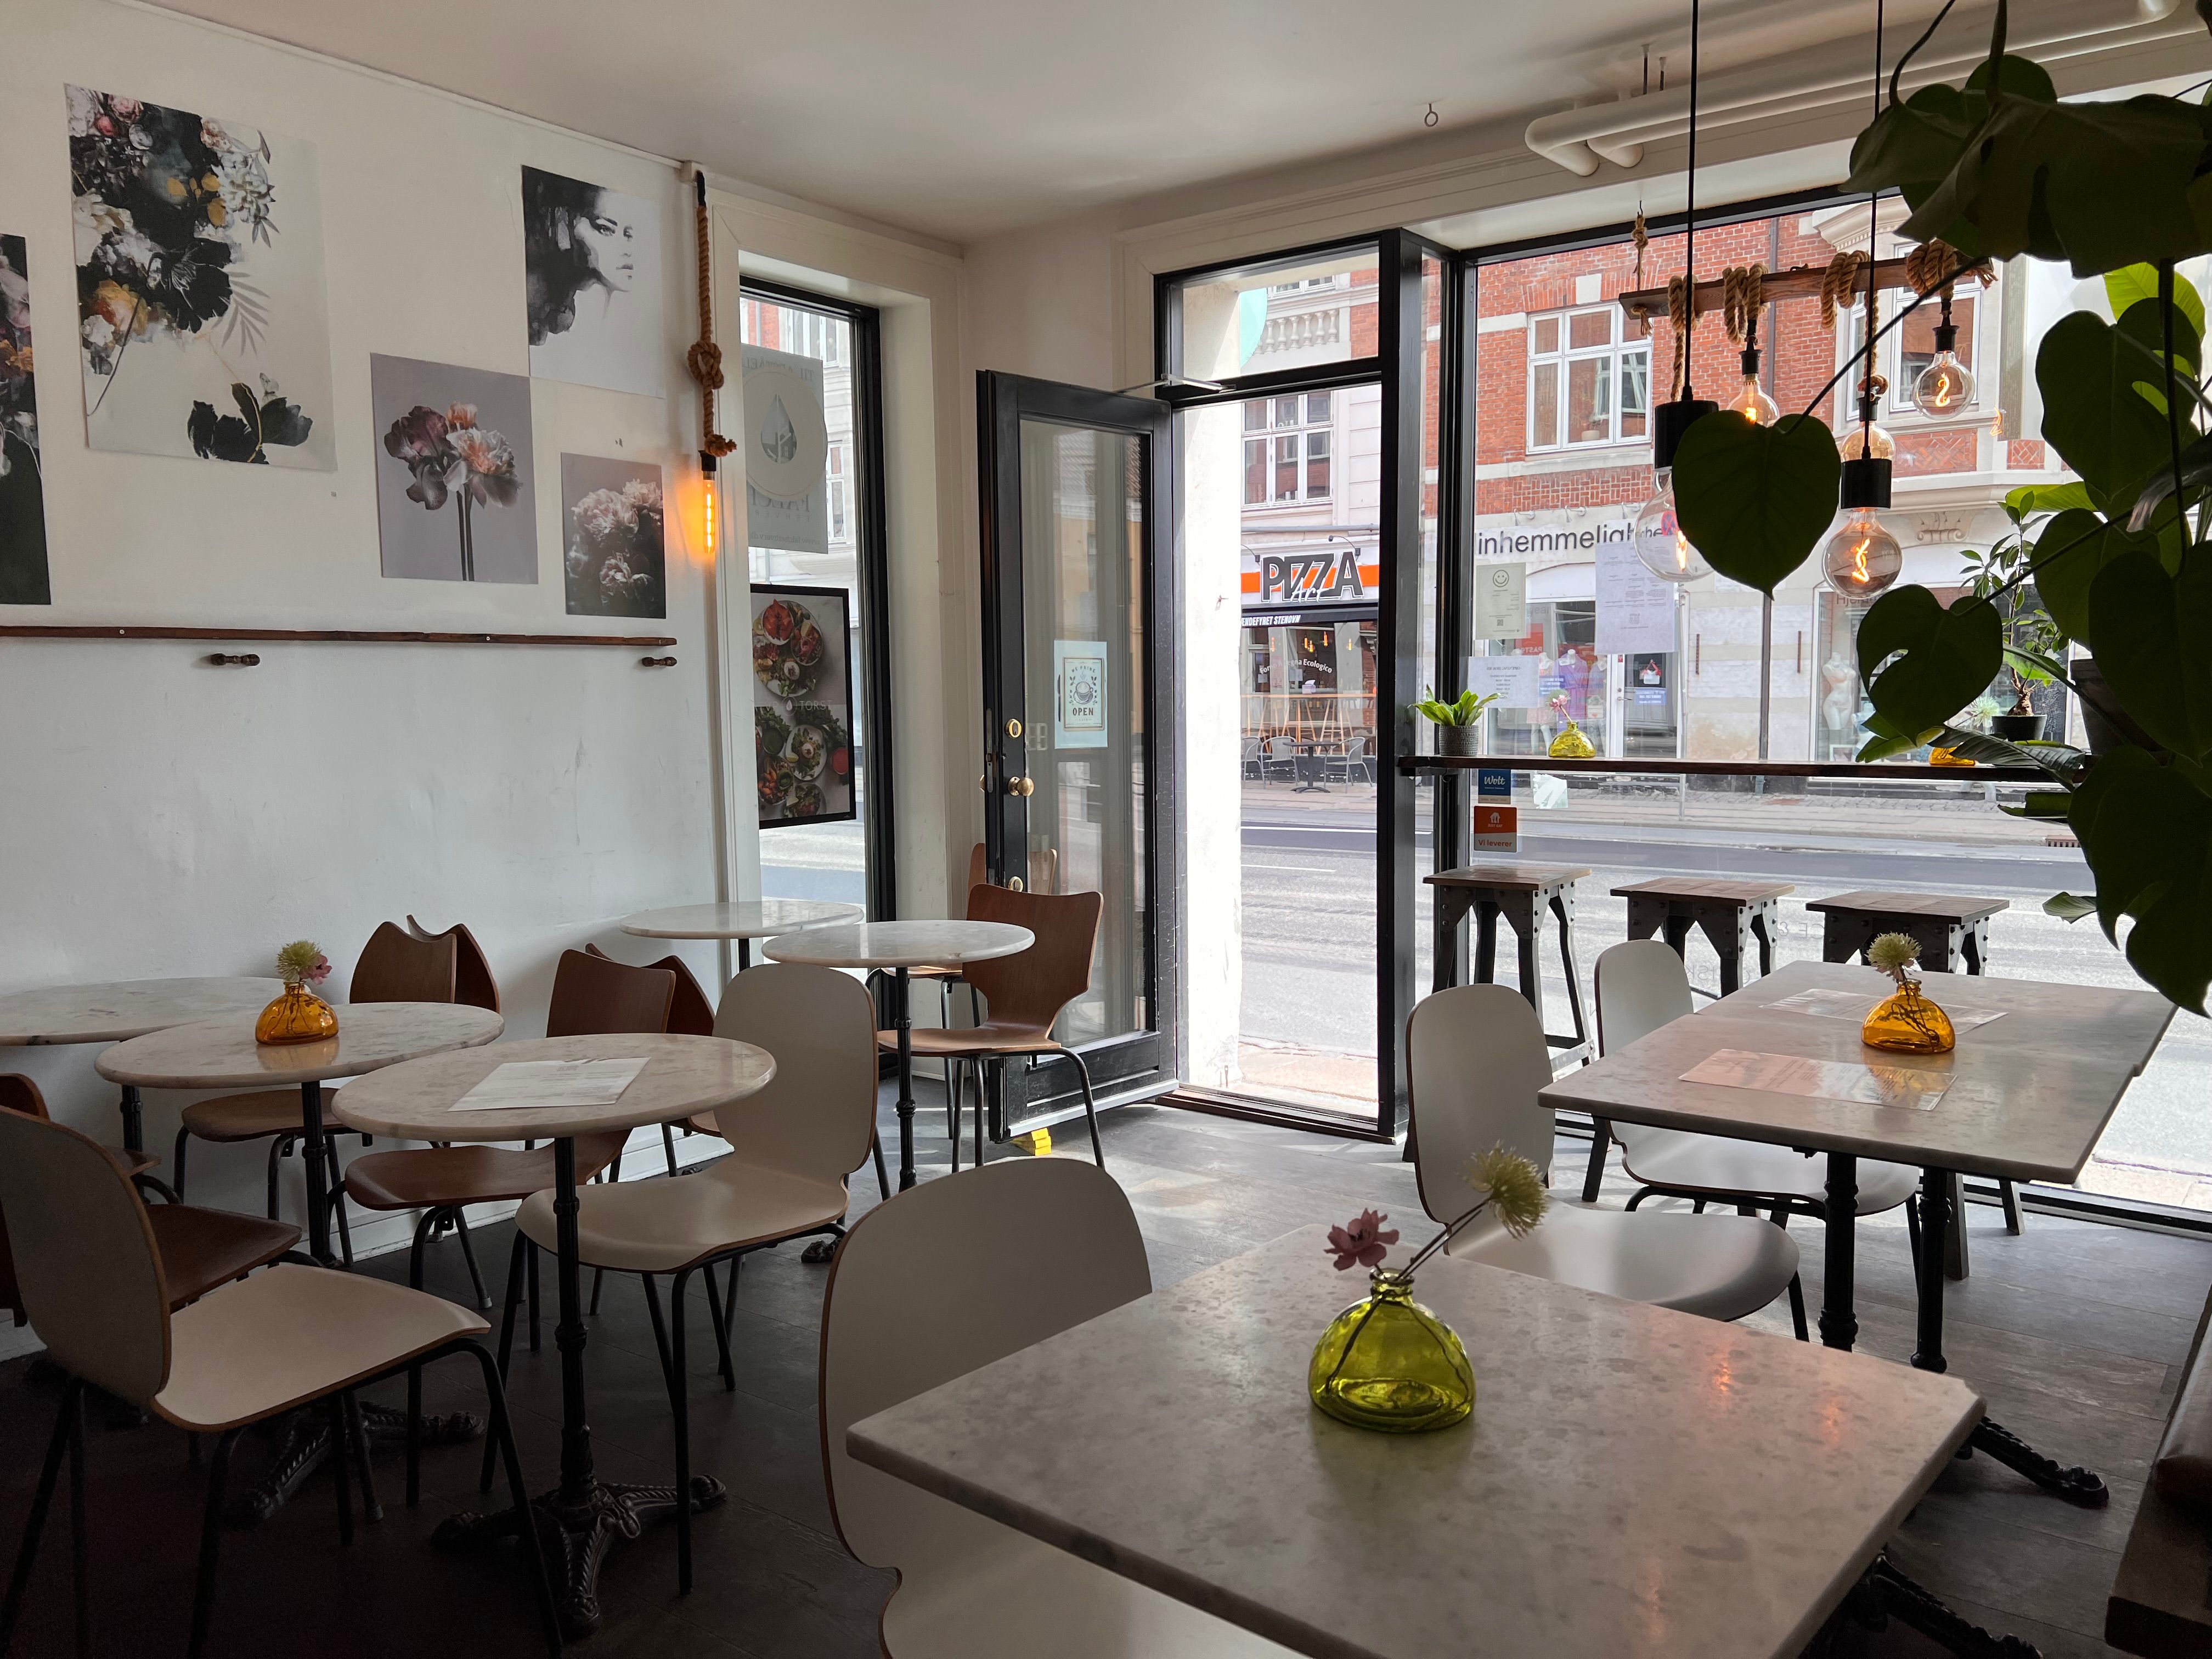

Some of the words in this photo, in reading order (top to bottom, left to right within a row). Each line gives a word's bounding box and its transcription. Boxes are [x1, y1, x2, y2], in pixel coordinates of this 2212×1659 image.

[1260, 550, 1364, 603] PIZZA
[1290, 577, 1329, 603] Art
[1273, 615, 1301, 625] STENOVN
[1260, 662, 1278, 675] Forno
[1286, 658, 1302, 667] egna
[1303, 658, 1333, 674] Ecologico
[1073, 707, 1093, 716] OPEN
[1484, 775, 1505, 785] Wolt
[1487, 839, 1513, 847] leverer
